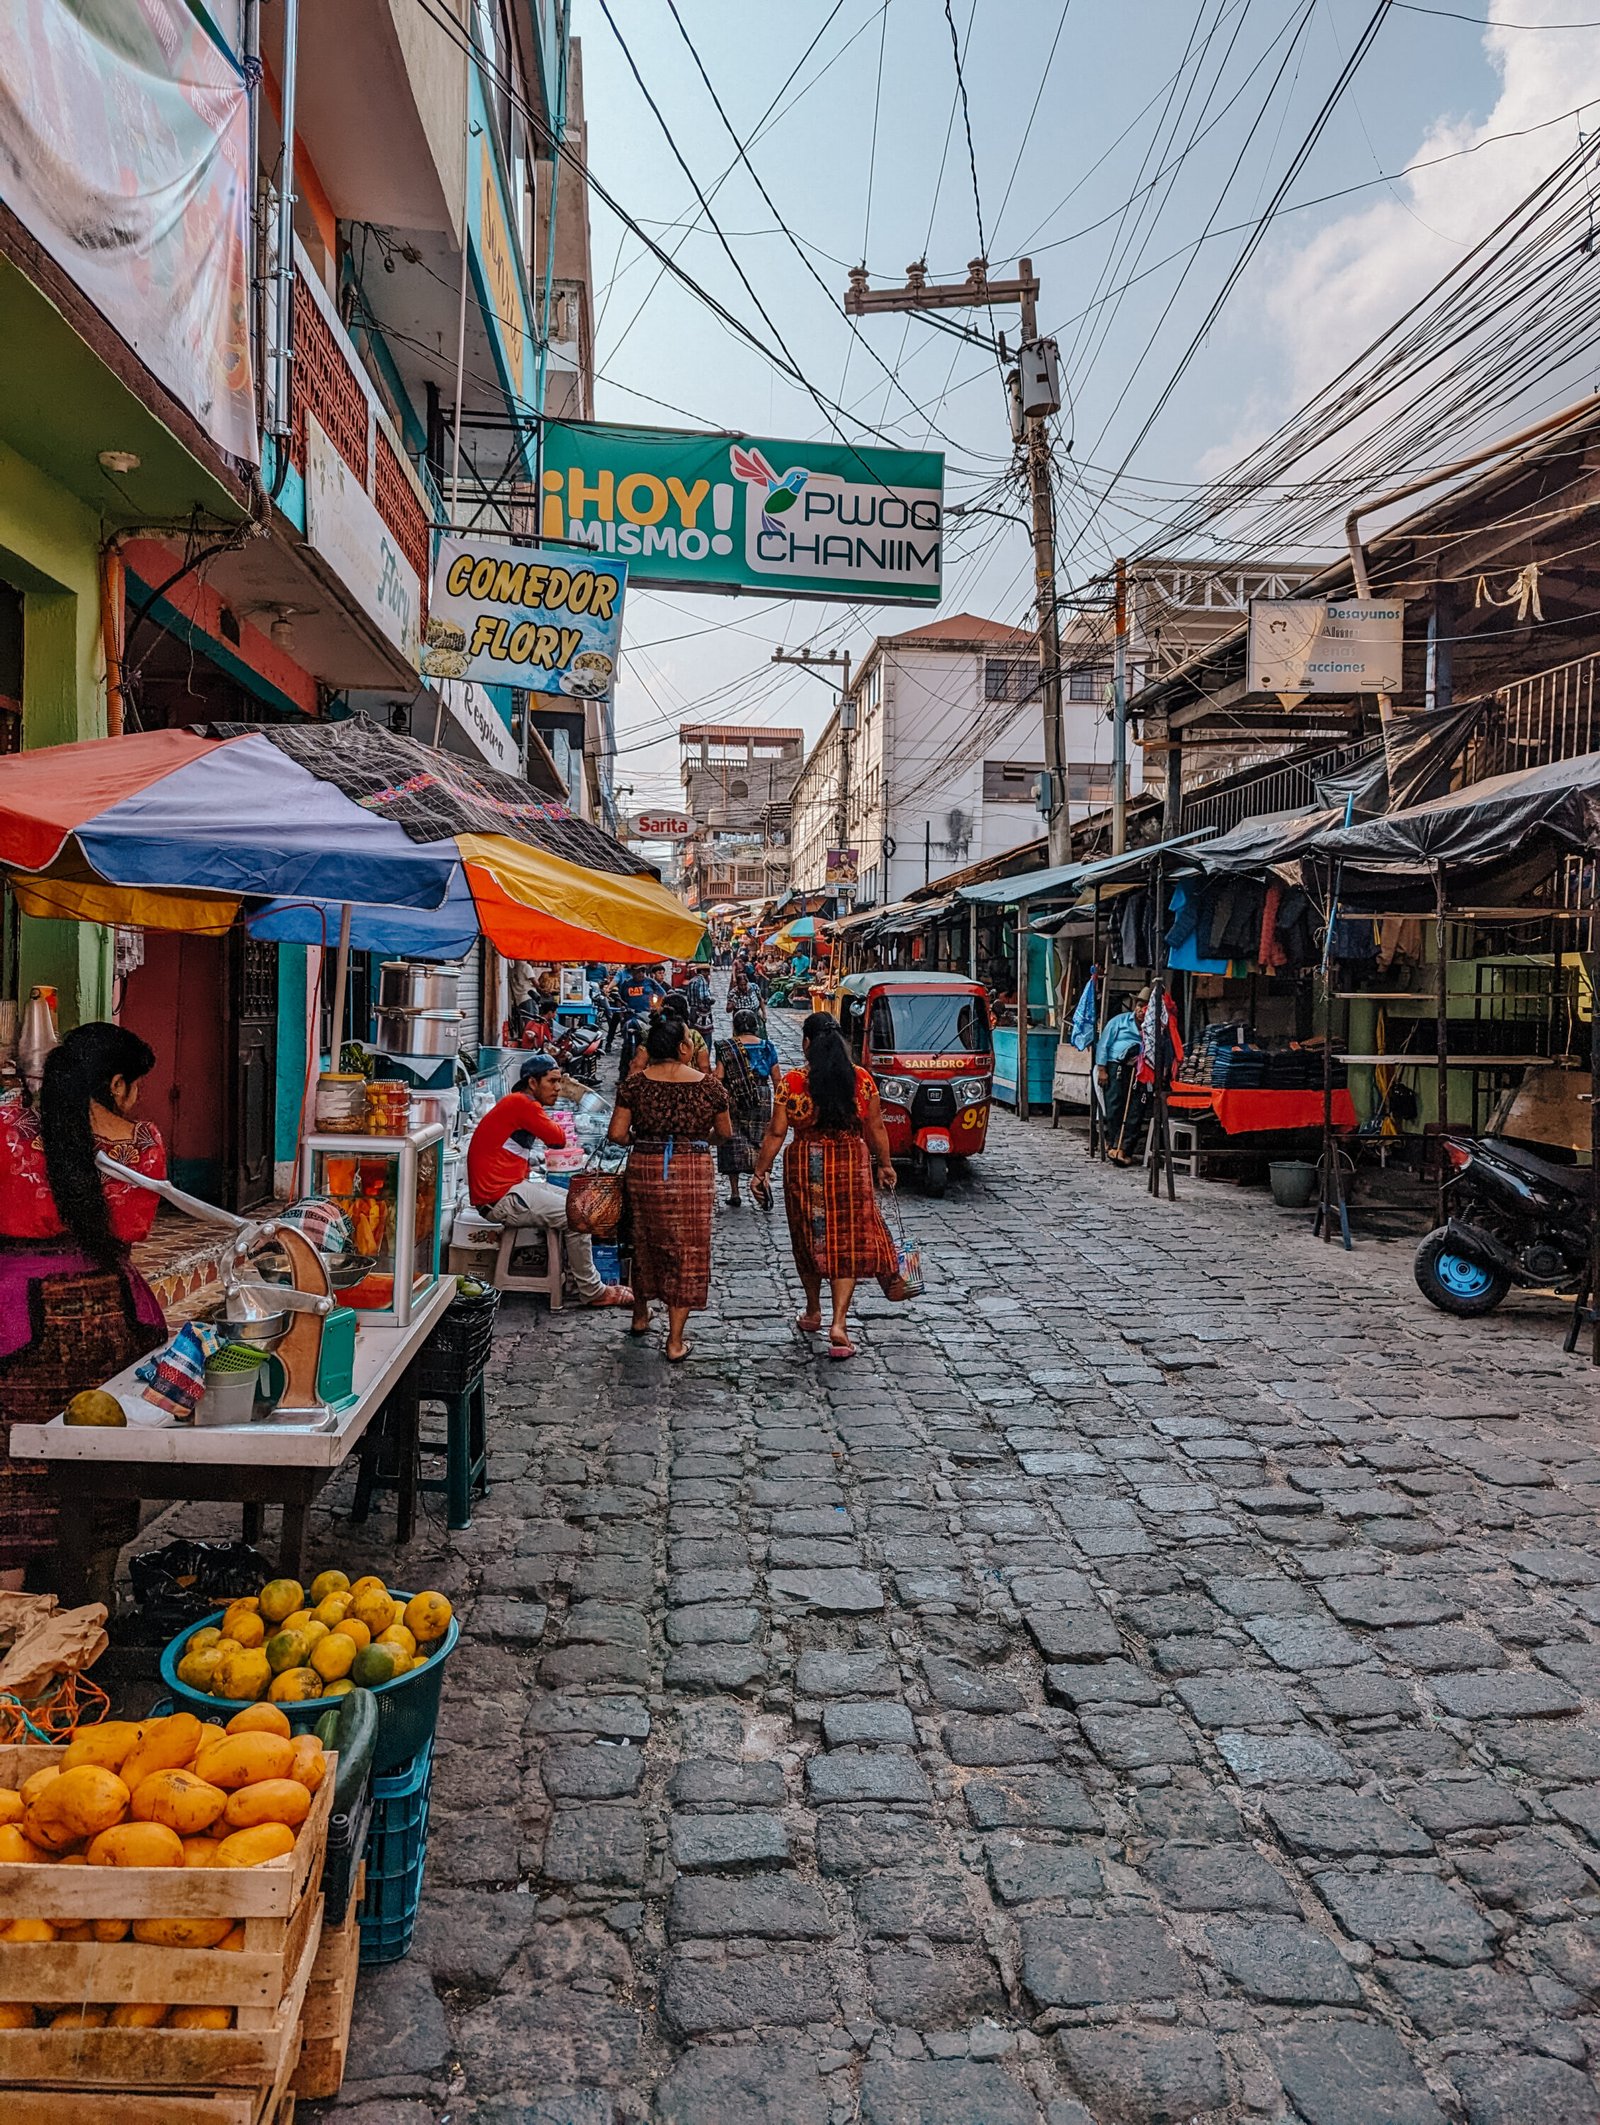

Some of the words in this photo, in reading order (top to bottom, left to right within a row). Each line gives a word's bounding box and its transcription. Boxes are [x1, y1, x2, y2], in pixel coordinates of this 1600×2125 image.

[756, 530, 941, 574] CHANIIM
[377, 536, 412, 646] Flory
[447, 554, 618, 621] COMEDOR
[1327, 607, 1400, 622] Desayunos
[468, 615, 583, 671] FLORY
[461, 680, 504, 761] Respira
[639, 816, 688, 833] Sarita
[629, 986, 644, 996] CAT
[905, 1059, 928, 1069] SAN
[929, 1059, 965, 1069] PEDRO
[961, 1106, 987, 1130] 93
